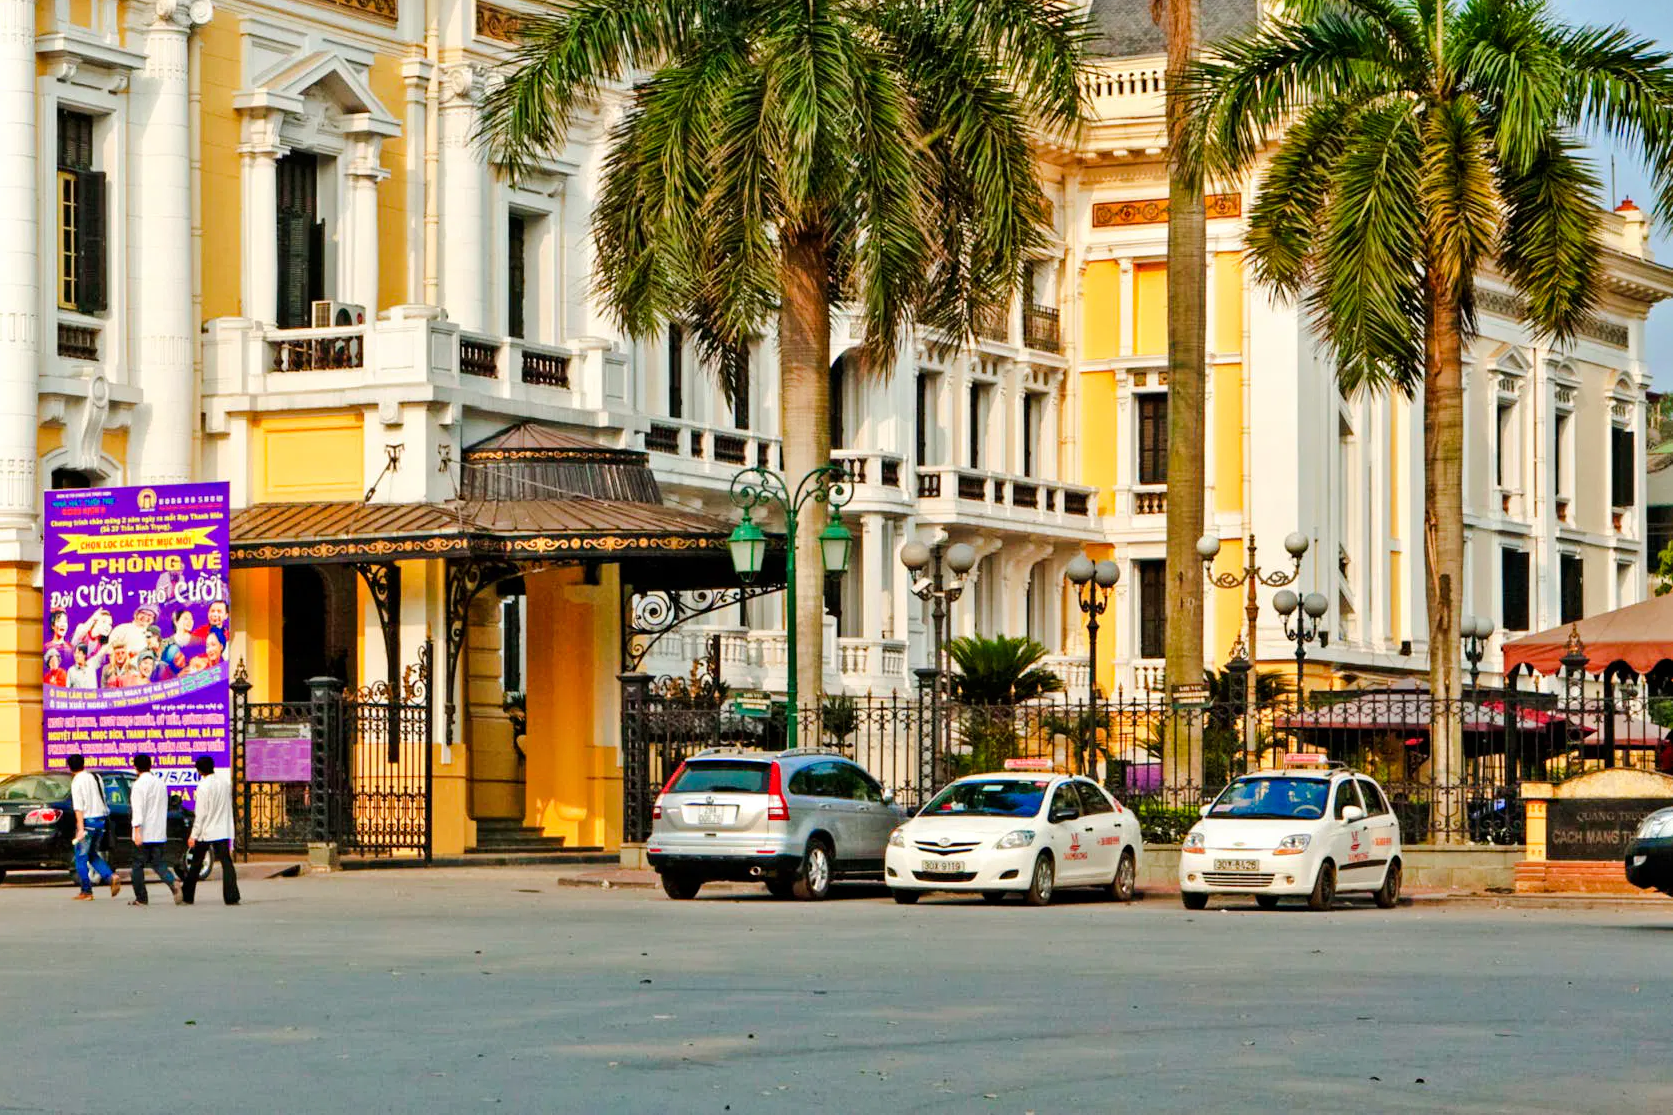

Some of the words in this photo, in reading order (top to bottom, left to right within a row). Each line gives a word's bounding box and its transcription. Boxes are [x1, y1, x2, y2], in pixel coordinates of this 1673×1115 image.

[80, 542, 101, 550] CHỌN
[104, 541, 117, 549] LỌC
[120, 539, 135, 548] CÁC
[137, 538, 154, 547] TIẾT
[157, 538, 173, 546] MỤC
[176, 536, 192, 545] MỚI
[91, 554, 180, 574] PHÒNG
[189, 550, 222, 569] VÉ
